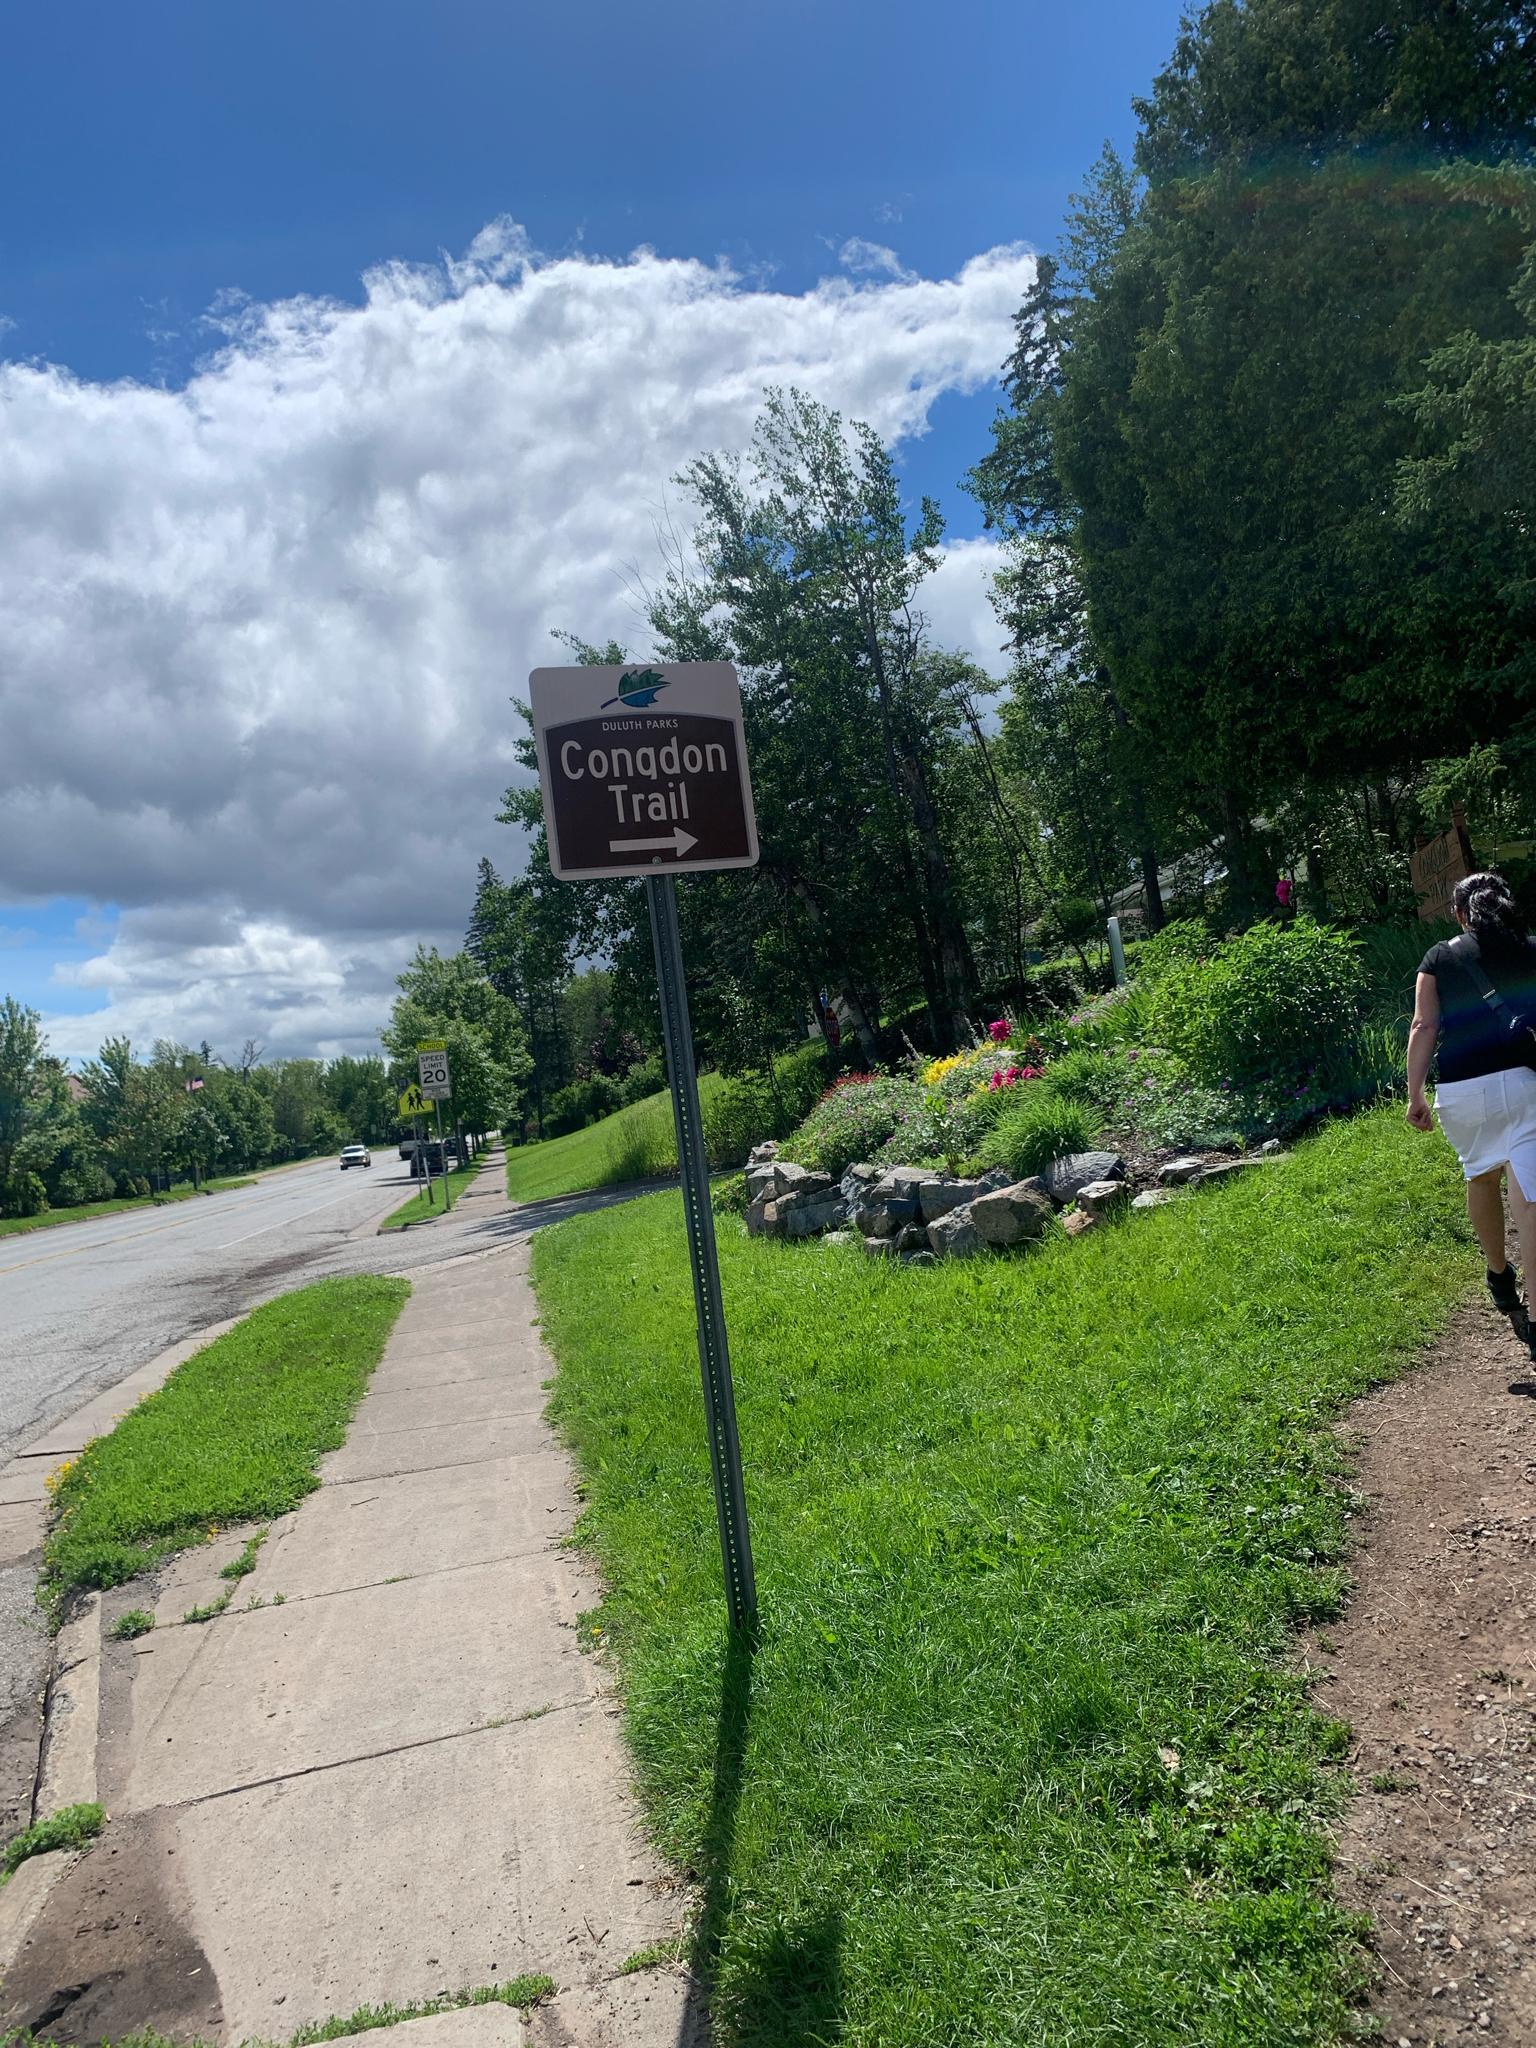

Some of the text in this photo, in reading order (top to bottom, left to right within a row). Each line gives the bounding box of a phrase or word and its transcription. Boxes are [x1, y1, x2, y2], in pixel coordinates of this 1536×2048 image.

[602, 719, 679, 731] DULUTH PARKS
[607, 781, 689, 824] Trail
[418, 1042, 443, 1050] SCHOOL
[420, 1054, 445, 1063] SPEED
[423, 1062, 443, 1070] LIMIT
[423, 1069, 446, 1084] 20
